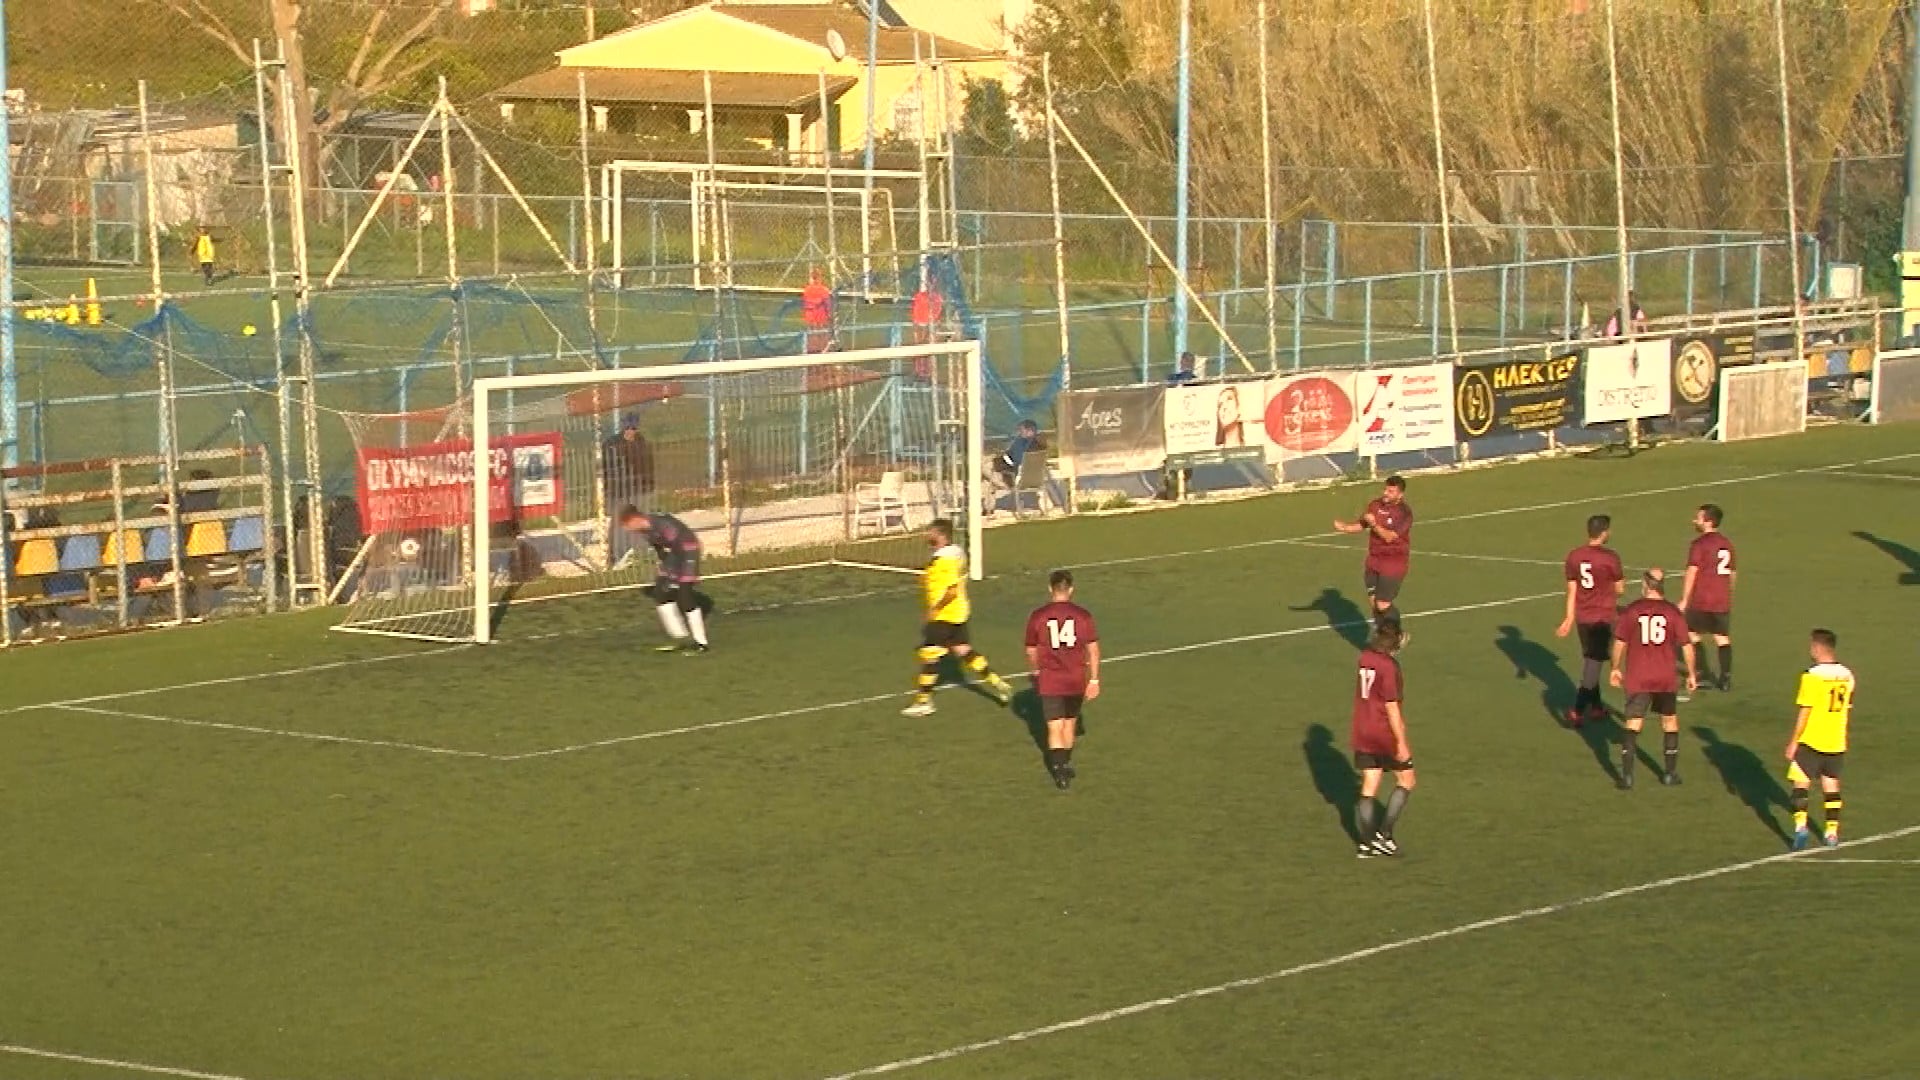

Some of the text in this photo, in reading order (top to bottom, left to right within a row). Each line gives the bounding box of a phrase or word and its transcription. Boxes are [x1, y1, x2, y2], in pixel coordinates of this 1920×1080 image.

[1580, 561, 1595, 589] 5
[1717, 548, 1731, 575] 2
[1046, 618, 1077, 649] 14
[1638, 614, 1667, 645] 16
[1358, 668, 1377, 699] 17
